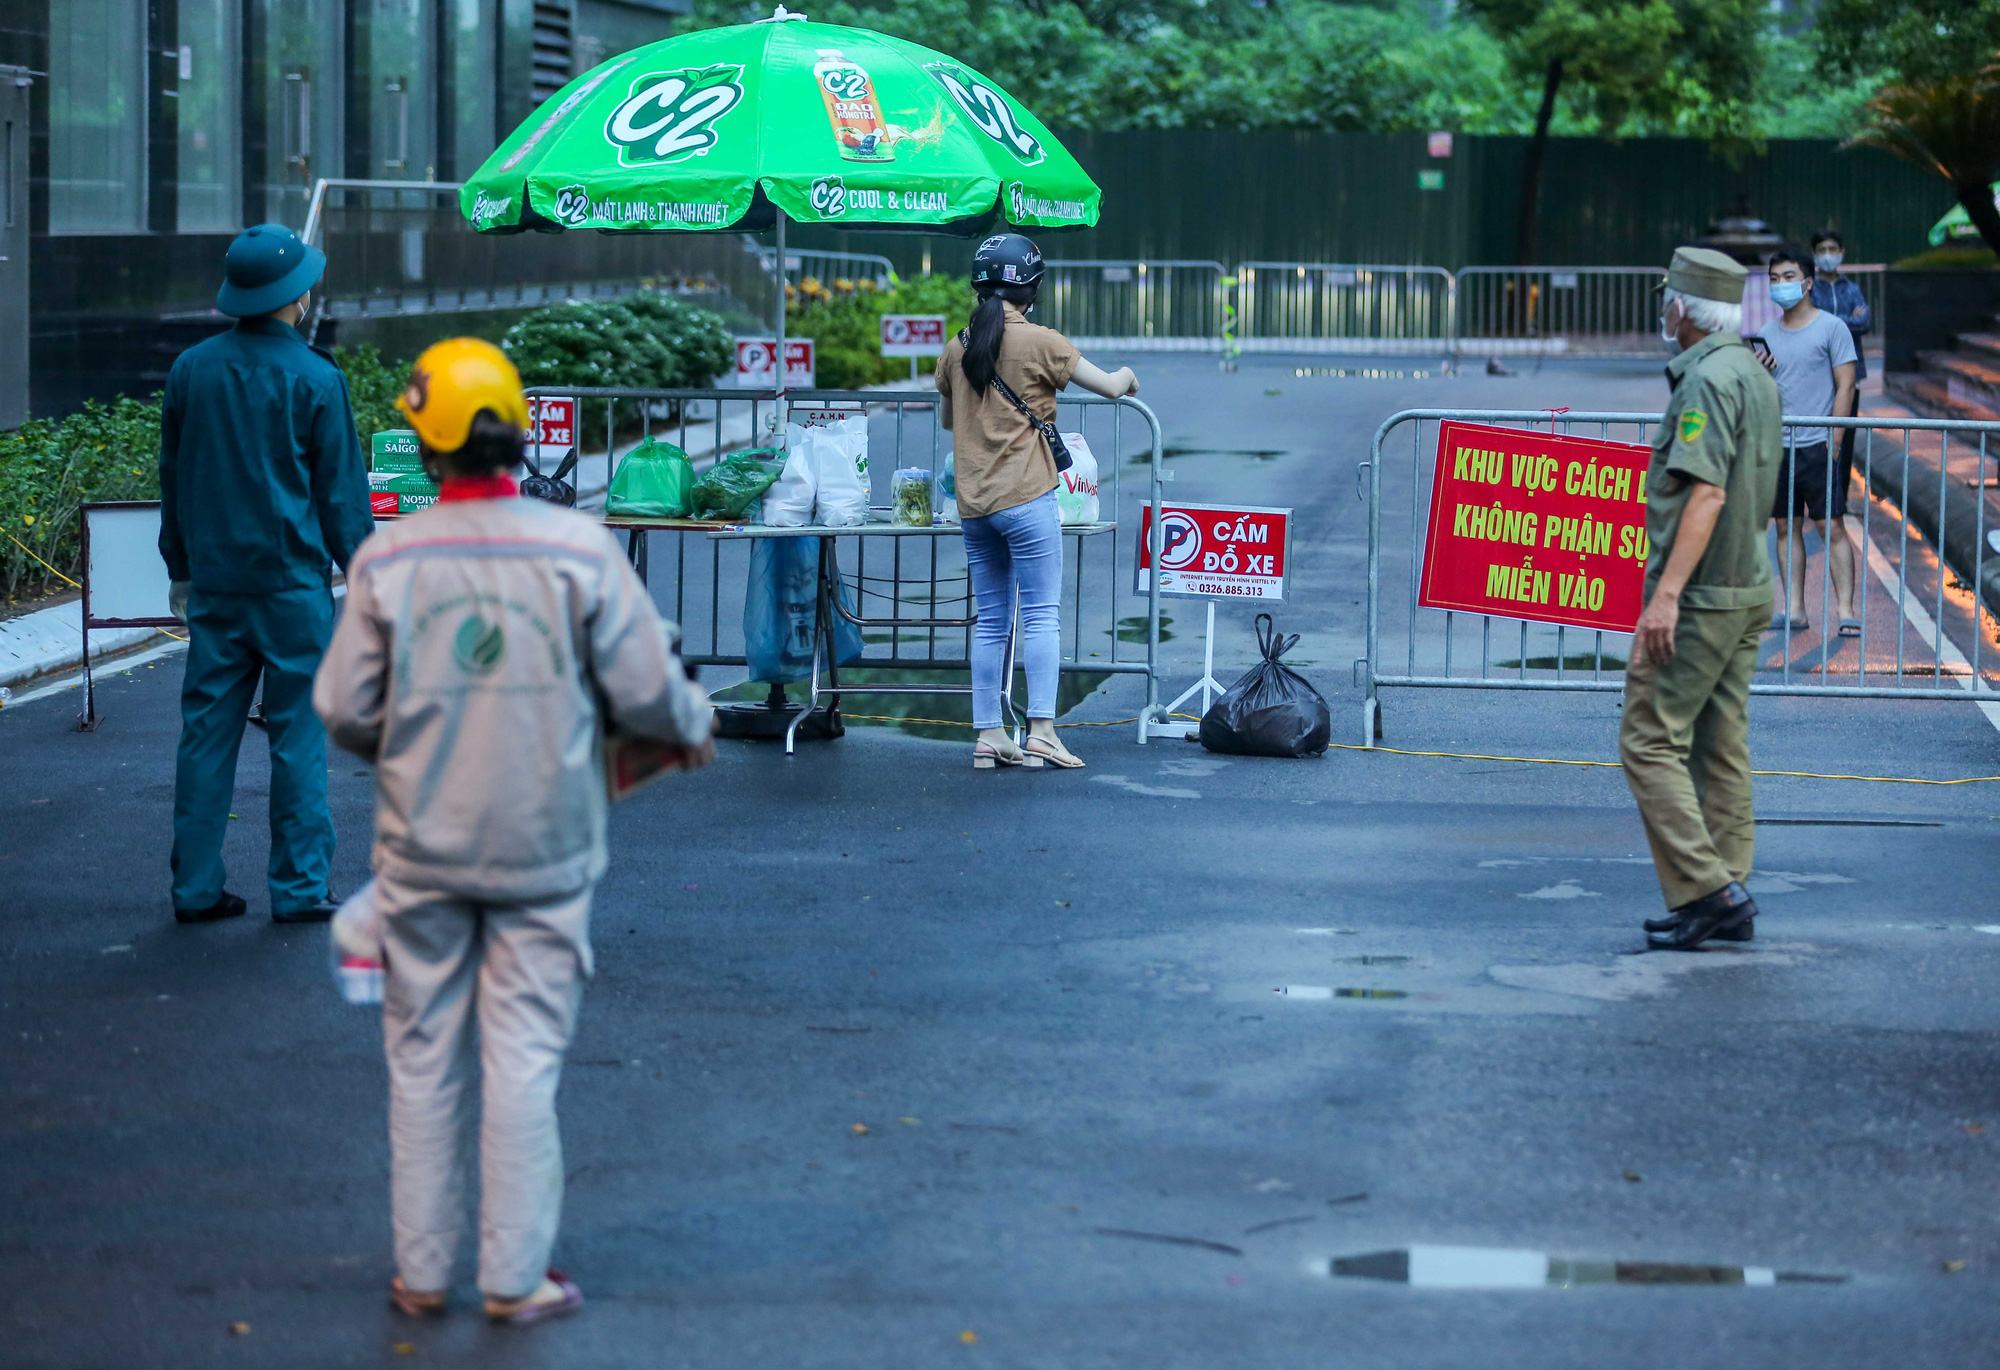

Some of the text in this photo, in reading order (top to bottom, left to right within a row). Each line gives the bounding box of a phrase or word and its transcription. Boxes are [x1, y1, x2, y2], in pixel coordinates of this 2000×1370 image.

[823, 71, 868, 98] C2
[608, 77, 740, 158] C2
[555, 190, 588, 224] C2
[592, 197, 616, 221] MÁT
[648, 206, 657, 221] &
[657, 202, 696, 222] THANH
[696, 199, 730, 223] KHIẾT
[811, 180, 948, 215] C2 COOL & CLEAN
[810, 412, 845, 420] C.A.H.N
[549, 428, 571, 443] XE
[1453, 446, 1505, 485] KHU
[1511, 454, 1559, 497] VỰC
[1565, 457, 1632, 502] CÁCH
[1213, 514, 1269, 544] CẤM
[1453, 501, 1538, 546] KHÔNG
[1543, 512, 1613, 561] PHẬN
[1203, 544, 1275, 575] ĐỖ XE
[1199, 583, 1263, 597] 0326.885.313
[1486, 555, 1606, 612] MIỄN VÀO
